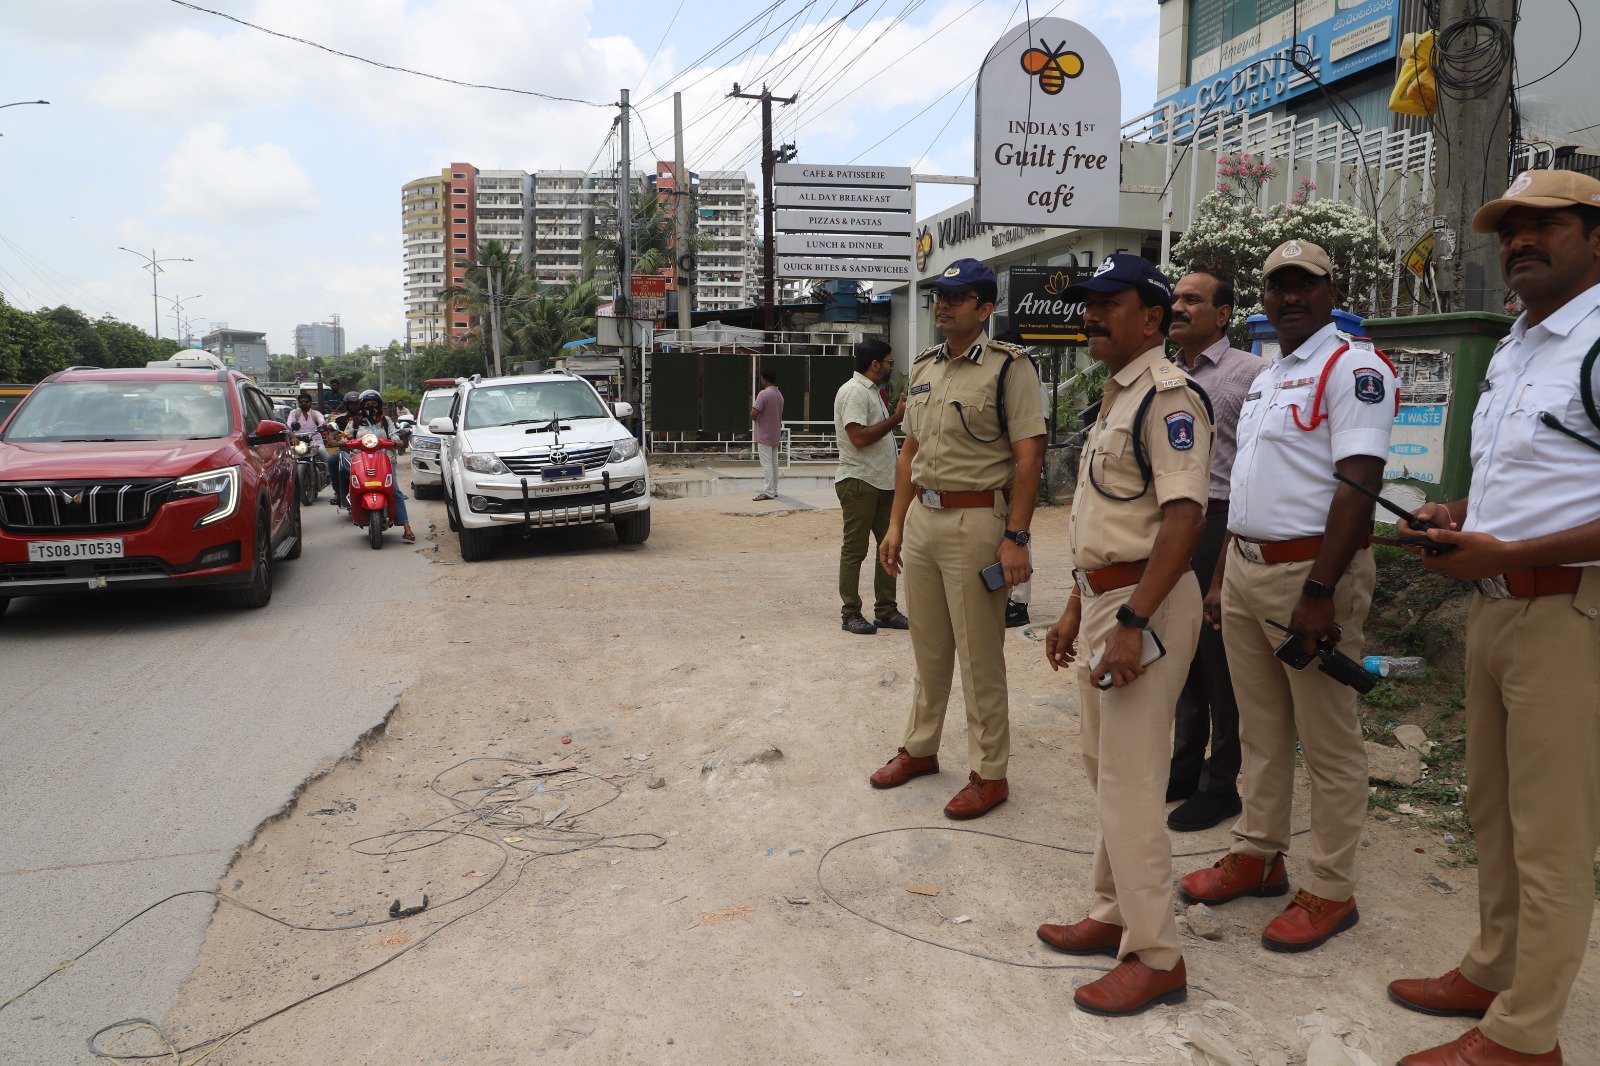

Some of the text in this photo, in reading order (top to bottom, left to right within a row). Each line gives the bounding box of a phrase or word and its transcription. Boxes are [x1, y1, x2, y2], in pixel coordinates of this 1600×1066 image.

[1231, 34, 1322, 96] DENTAL
[1223, 81, 1285, 115] WORLD
[1008, 120, 1070, 136] INDIA'S
[994, 142, 1108, 175] Guilt free
[802, 168, 886, 179] CAFÉ & PATISSERIE
[798, 193, 891, 203] ALL DAY BREAKFAST
[1027, 183, 1075, 214] café
[808, 217, 882, 226] PIZZAS & PASTAS
[806, 241, 884, 250] LUNCH & DINNER
[783, 262, 909, 274] QUICK BITES & SANDWICHES
[1014, 292, 1087, 322] Ameya
[1394, 413, 1440, 423] ET WASTE
[1395, 445, 1421, 453] USE ME
[37, 542, 121, 558] TS08JT0539
